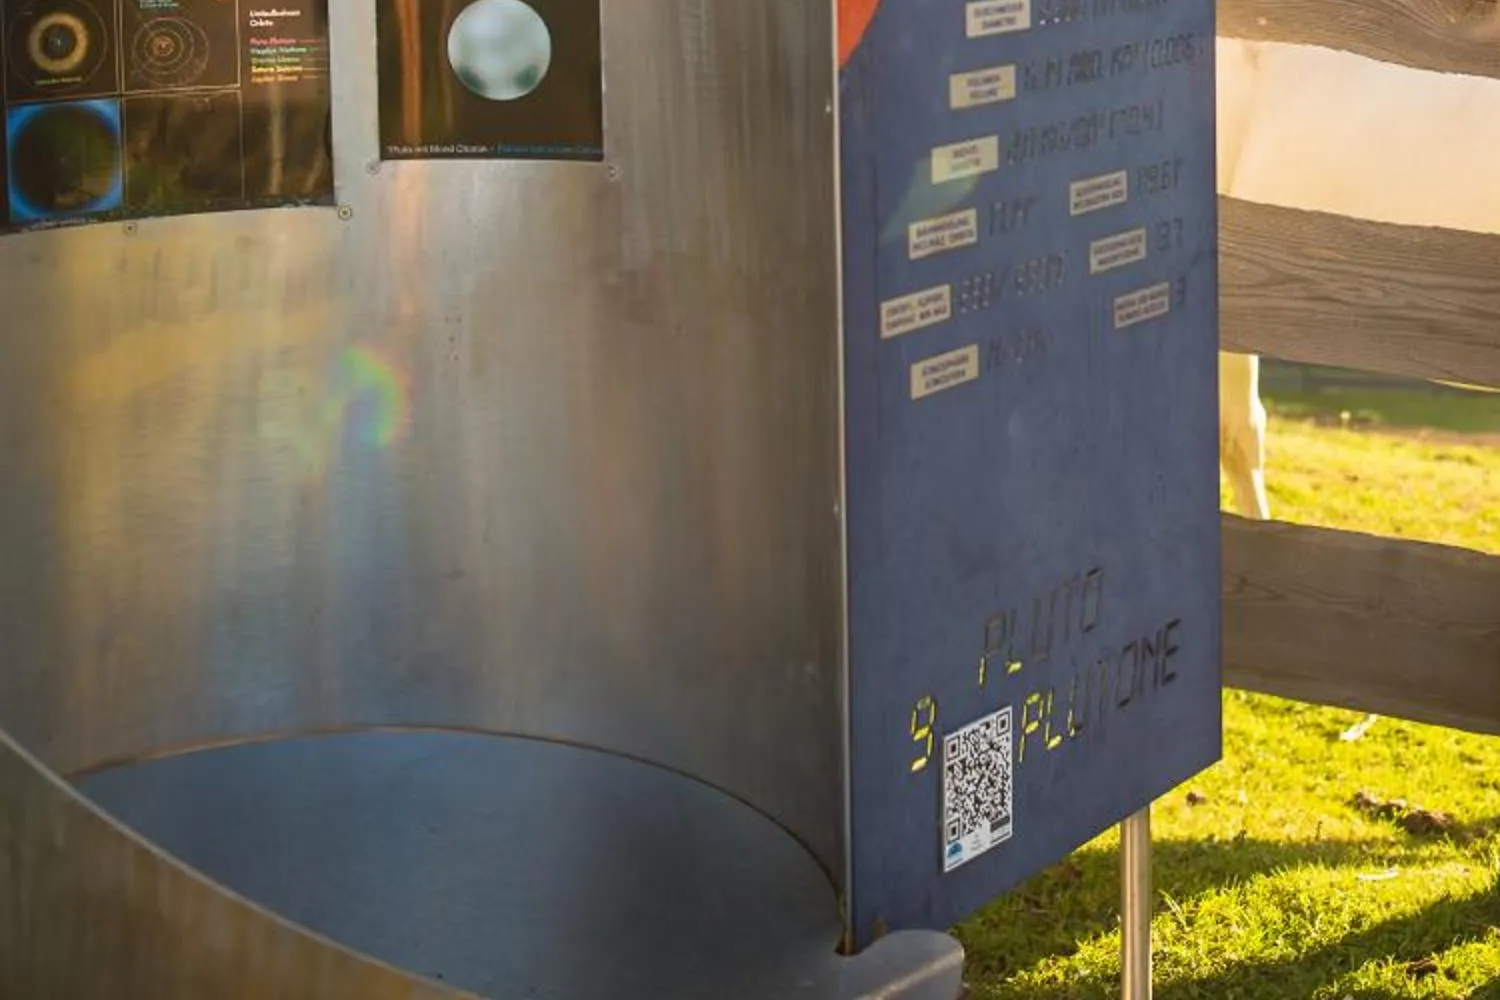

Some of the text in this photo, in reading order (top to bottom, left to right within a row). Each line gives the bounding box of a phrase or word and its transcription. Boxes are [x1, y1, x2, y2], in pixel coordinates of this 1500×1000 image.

[978, 566, 1103, 686] PLUTO
[910, 695, 935, 772] 9
[1019, 617, 1182, 763] PLUTONE
